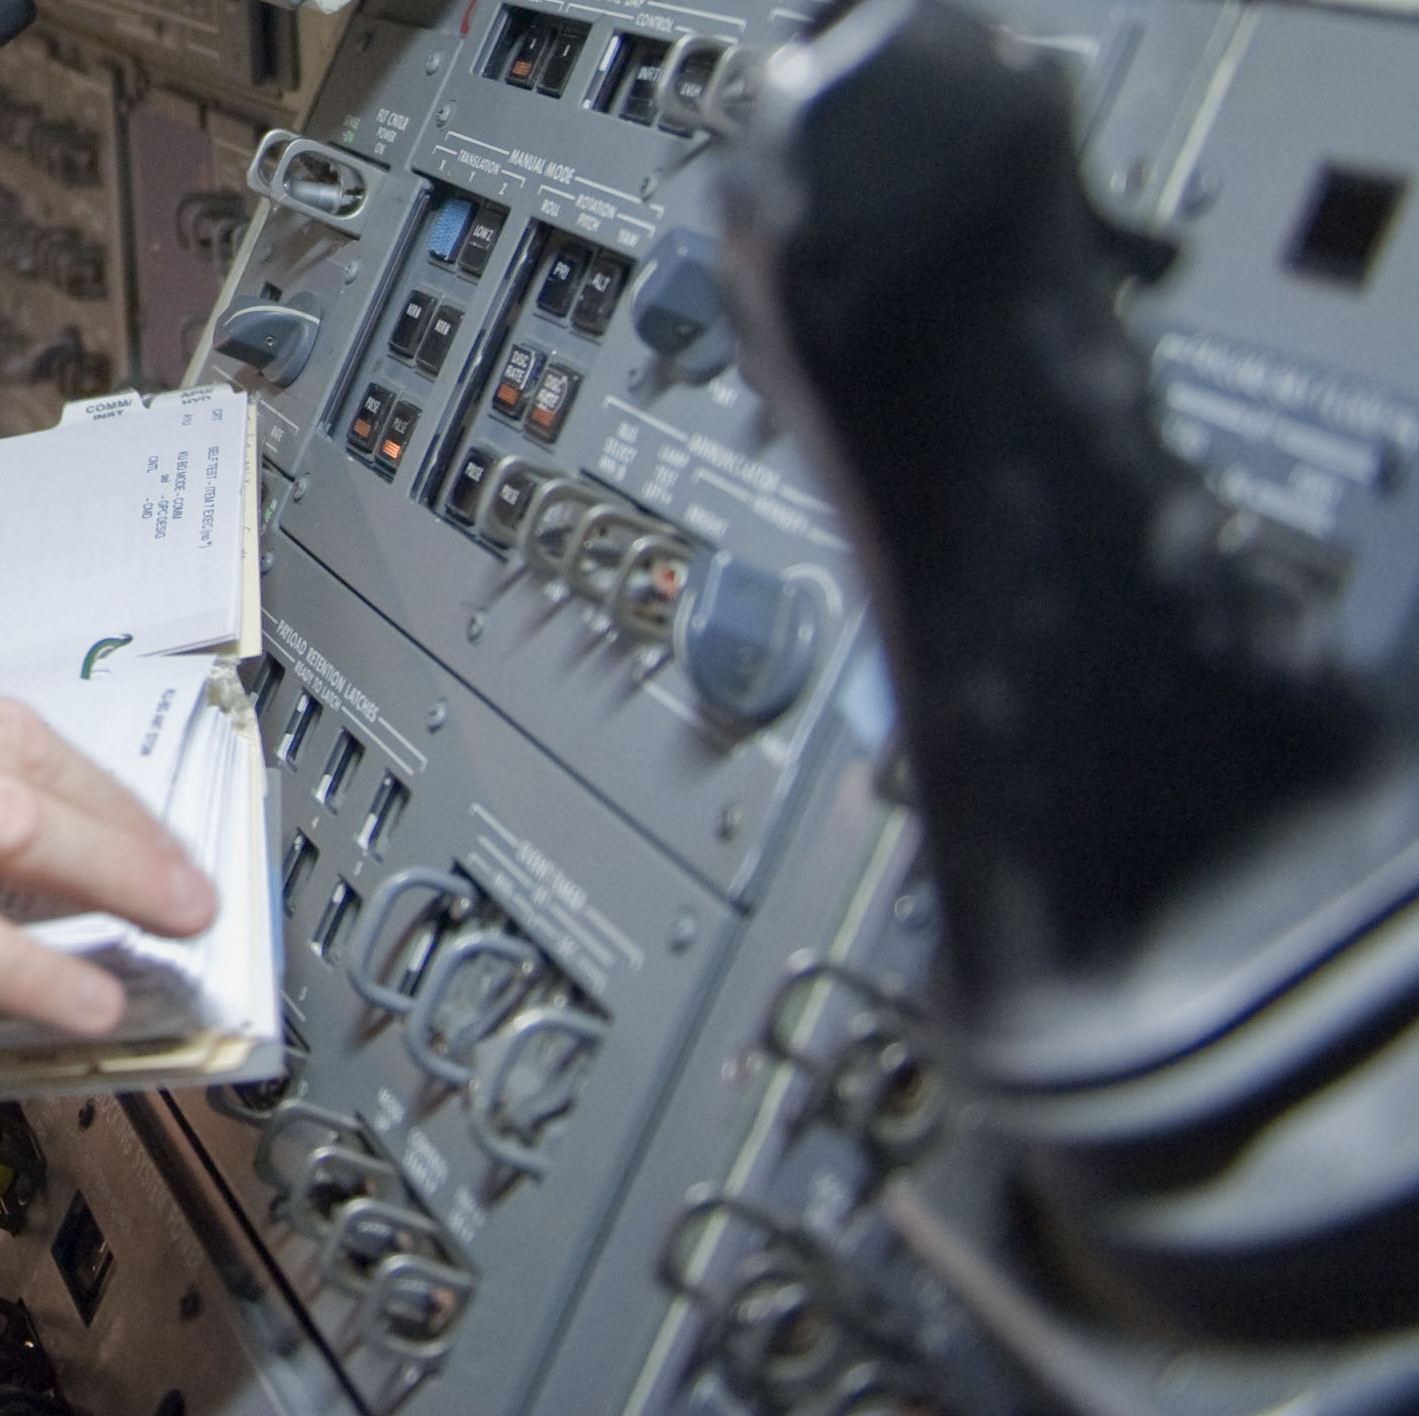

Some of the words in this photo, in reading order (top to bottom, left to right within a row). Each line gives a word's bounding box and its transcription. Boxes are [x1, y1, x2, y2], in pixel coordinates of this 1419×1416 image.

[635, 11, 676, 34] CONTROL
[375, 126, 397, 143] POWER
[457, 149, 502, 176] TRANSLATION
[508, 148, 548, 176] MANUAL
[544, 162, 577, 185] MODE
[541, 198, 563, 218] ROLL
[575, 211, 603, 233] PITCH
[574, 193, 619, 220] ROTATION
[553, 260, 571, 281] PRI
[591, 271, 612, 293] ALT
[511, 349, 531, 369] DISC
[504, 367, 526, 385] RATE
[207, 445, 219, 464] SELF
[173, 471, 186, 492] MODE
[205, 463, 217, 479] TEST
[203, 486, 215, 503] ITEM
[171, 497, 183, 520] COMM
[201, 510, 213, 530] EXEC
[275, 619, 308, 655] PAYLOAD
[305, 647, 348, 693] RETENTION
[343, 682, 380, 724] LATCHES
[294, 660, 314, 685] READY
[311, 676, 324, 694] TO
[321, 685, 343, 713] LATCH
